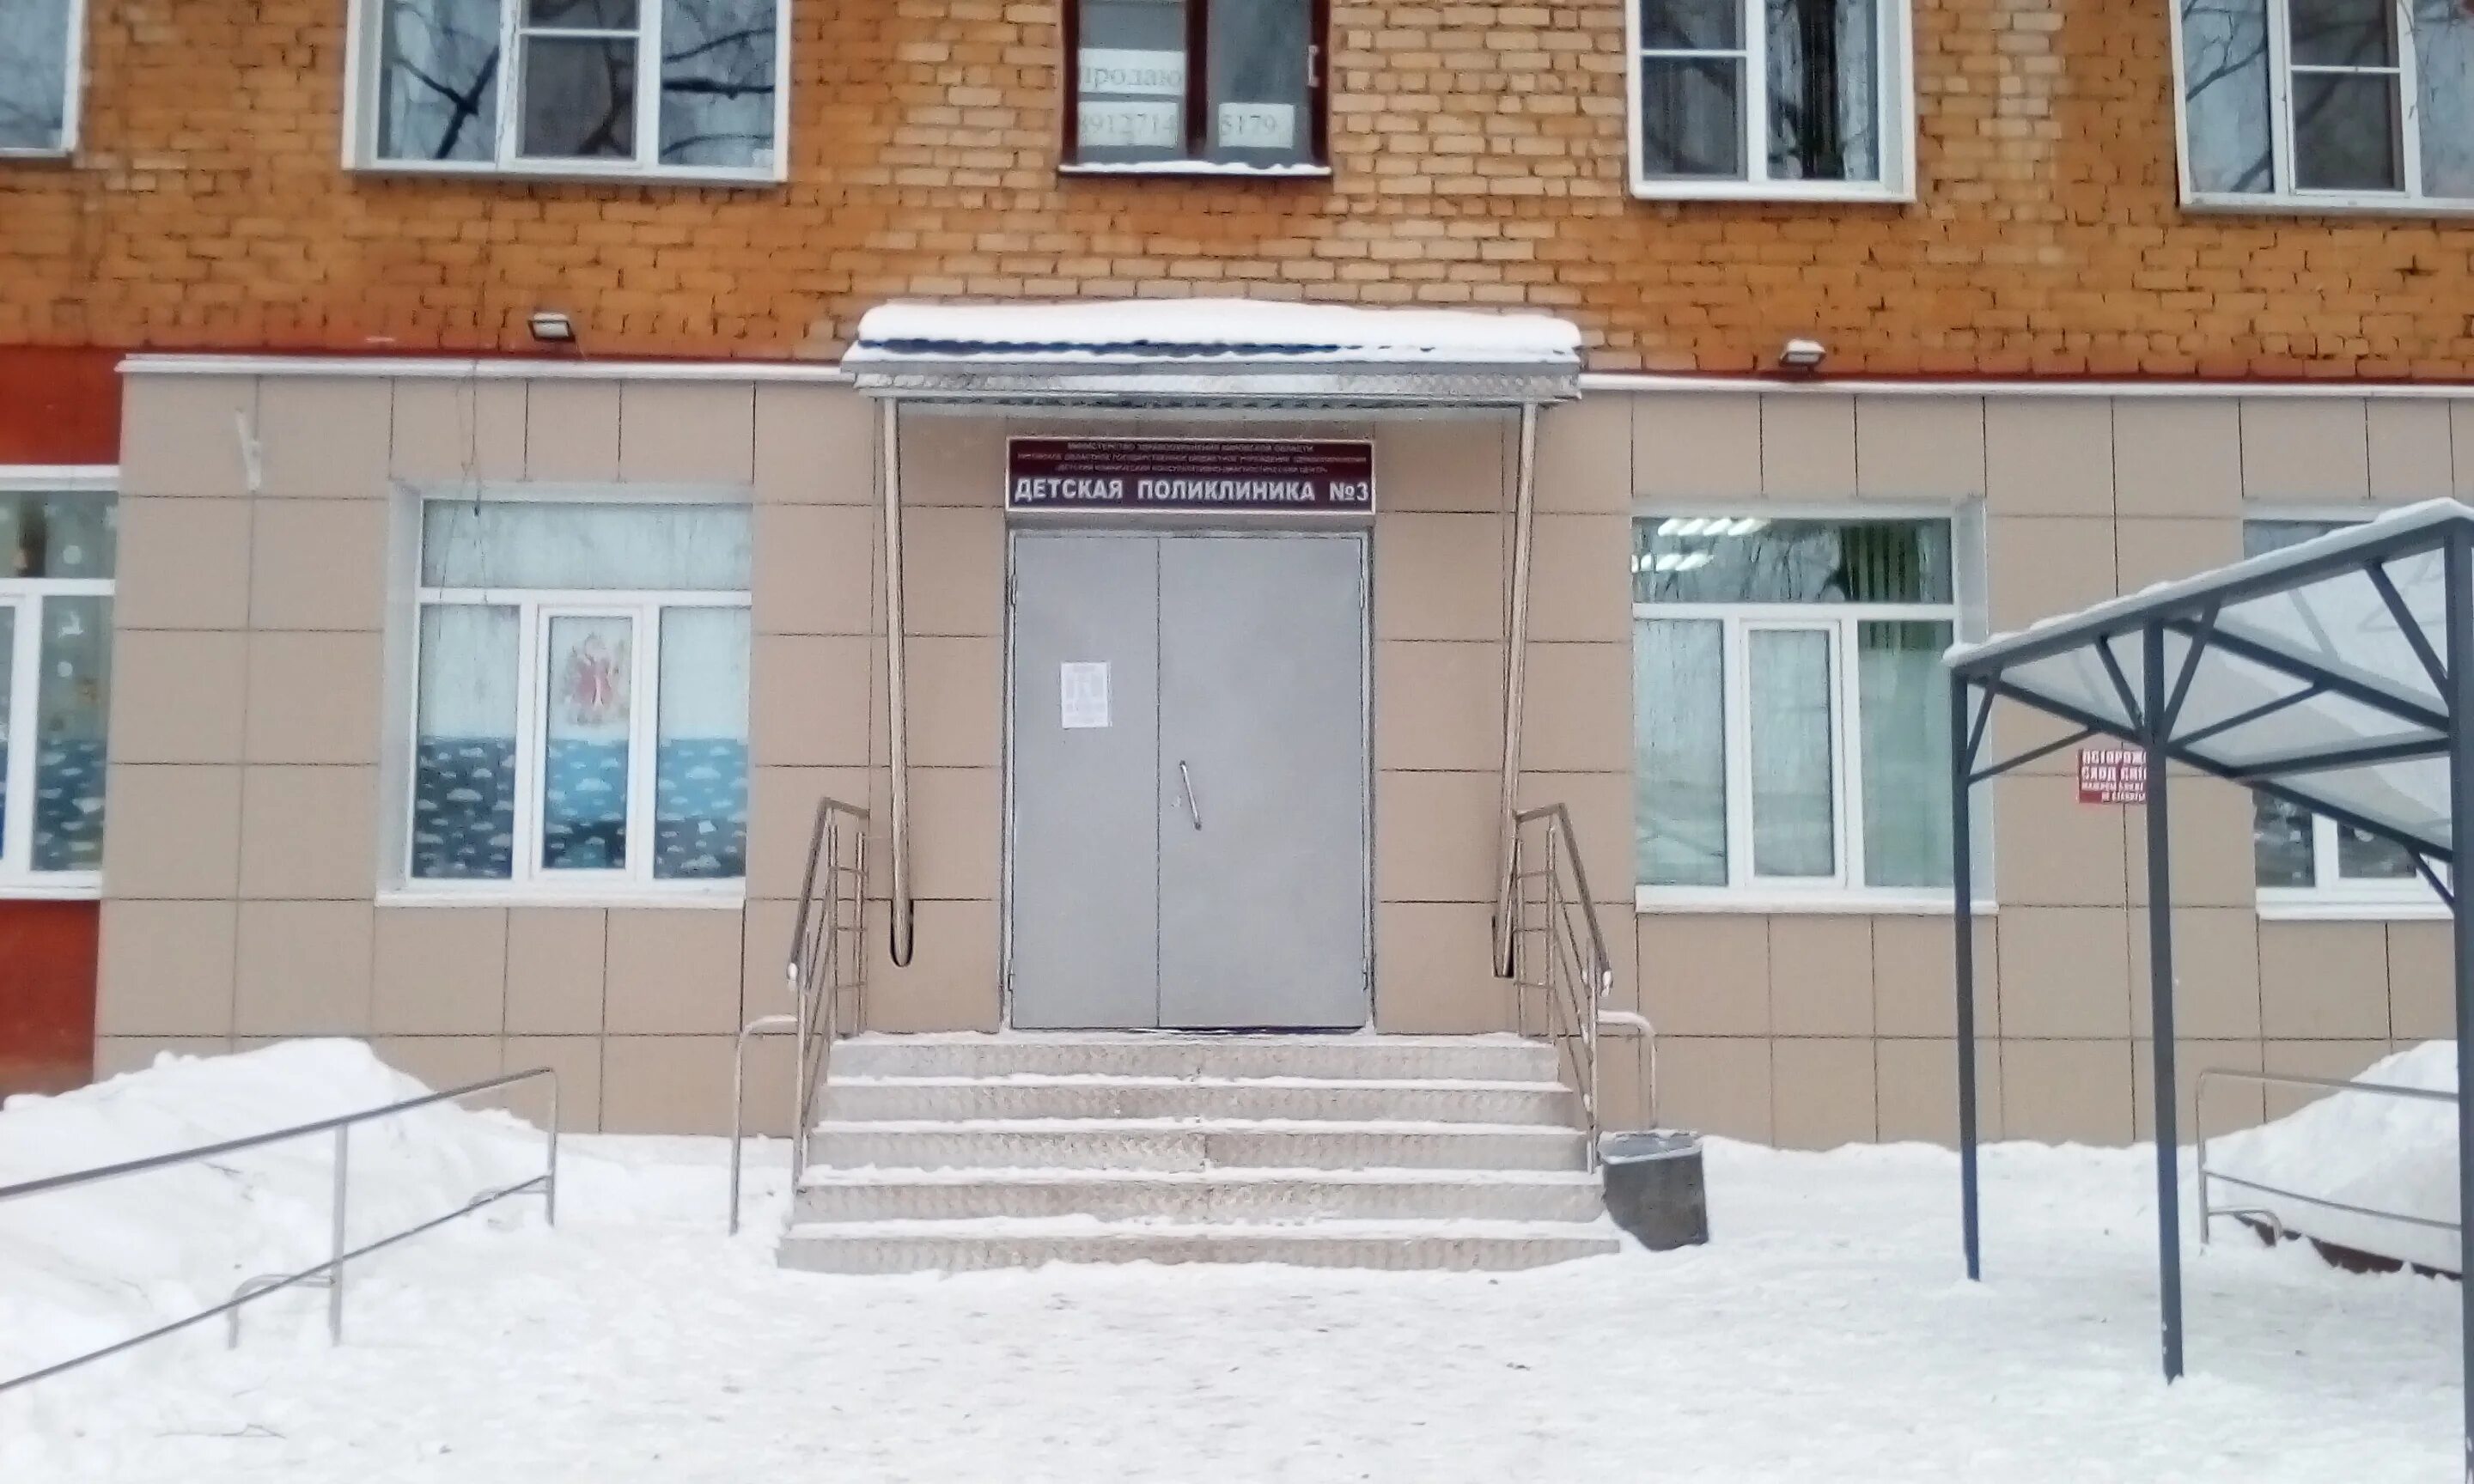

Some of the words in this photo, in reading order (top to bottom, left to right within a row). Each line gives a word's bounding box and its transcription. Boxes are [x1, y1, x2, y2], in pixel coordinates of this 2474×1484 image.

[1015, 477, 1123, 502] ДЕТСКАЯ
[1137, 479, 1315, 501] ПОЛИКЛИНИКА
[1329, 481, 1369, 501] №3
